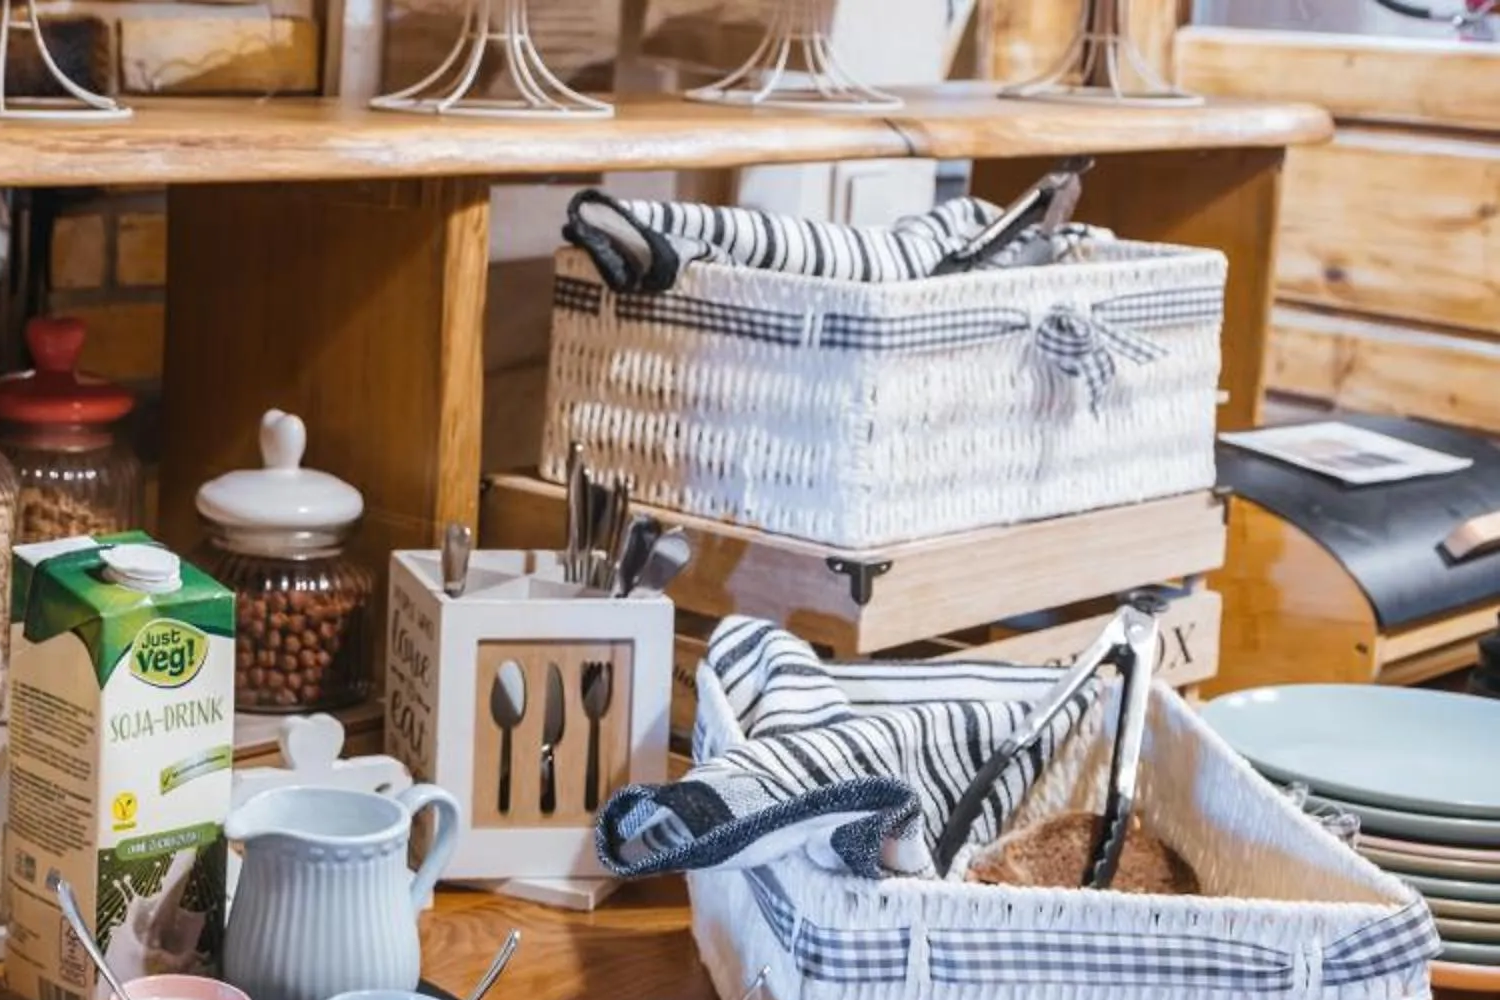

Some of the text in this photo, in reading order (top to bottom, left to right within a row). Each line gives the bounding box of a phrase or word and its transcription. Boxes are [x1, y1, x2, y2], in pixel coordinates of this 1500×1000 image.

[135, 638, 195, 677] veg!
[140, 629, 181, 650] Just
[109, 695, 225, 743] SOJA-DRINK
